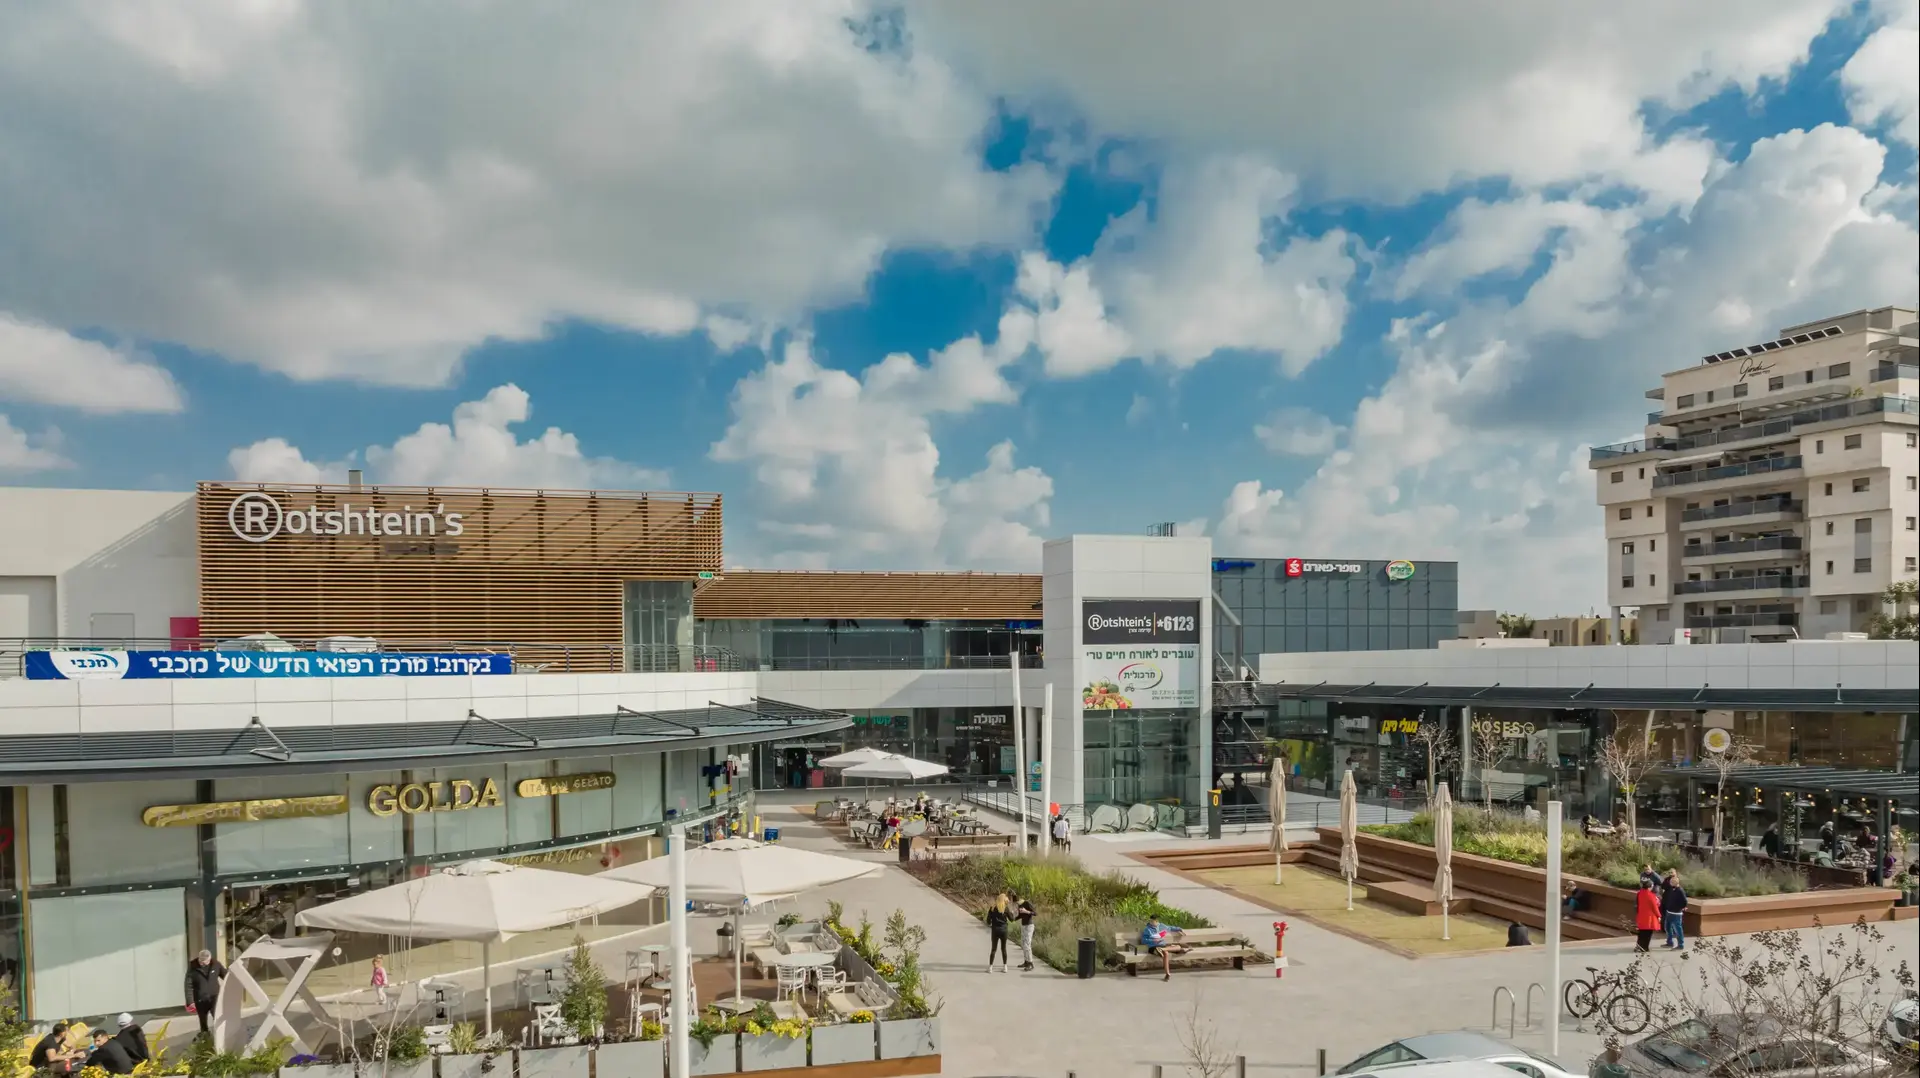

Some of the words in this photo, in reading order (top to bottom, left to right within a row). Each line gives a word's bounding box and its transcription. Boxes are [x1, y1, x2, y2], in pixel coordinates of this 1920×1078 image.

[228, 491, 464, 543] Rotshtein's
[1302, 562, 1361, 574] סופר-פארם
[1088, 614, 1152, 630] Rotshtein's
[1086, 651, 1103, 660] טרי
[1105, 651, 1126, 660] חיים
[1129, 648, 1159, 659] לאורח
[1161, 650, 1194, 659] עוברים
[70, 657, 108, 669] מכבי
[149, 656, 208, 674] מכבי
[216, 653, 250, 673] של
[259, 656, 310, 674] חדש
[316, 656, 374, 674] רפואי
[380, 656, 428, 674] מרכז
[434, 656, 491, 675] בקרוב!
[1471, 721, 1521, 734] MOSES
[573, 776, 611, 789] GELATO
[368, 777, 504, 817] GOLDA
